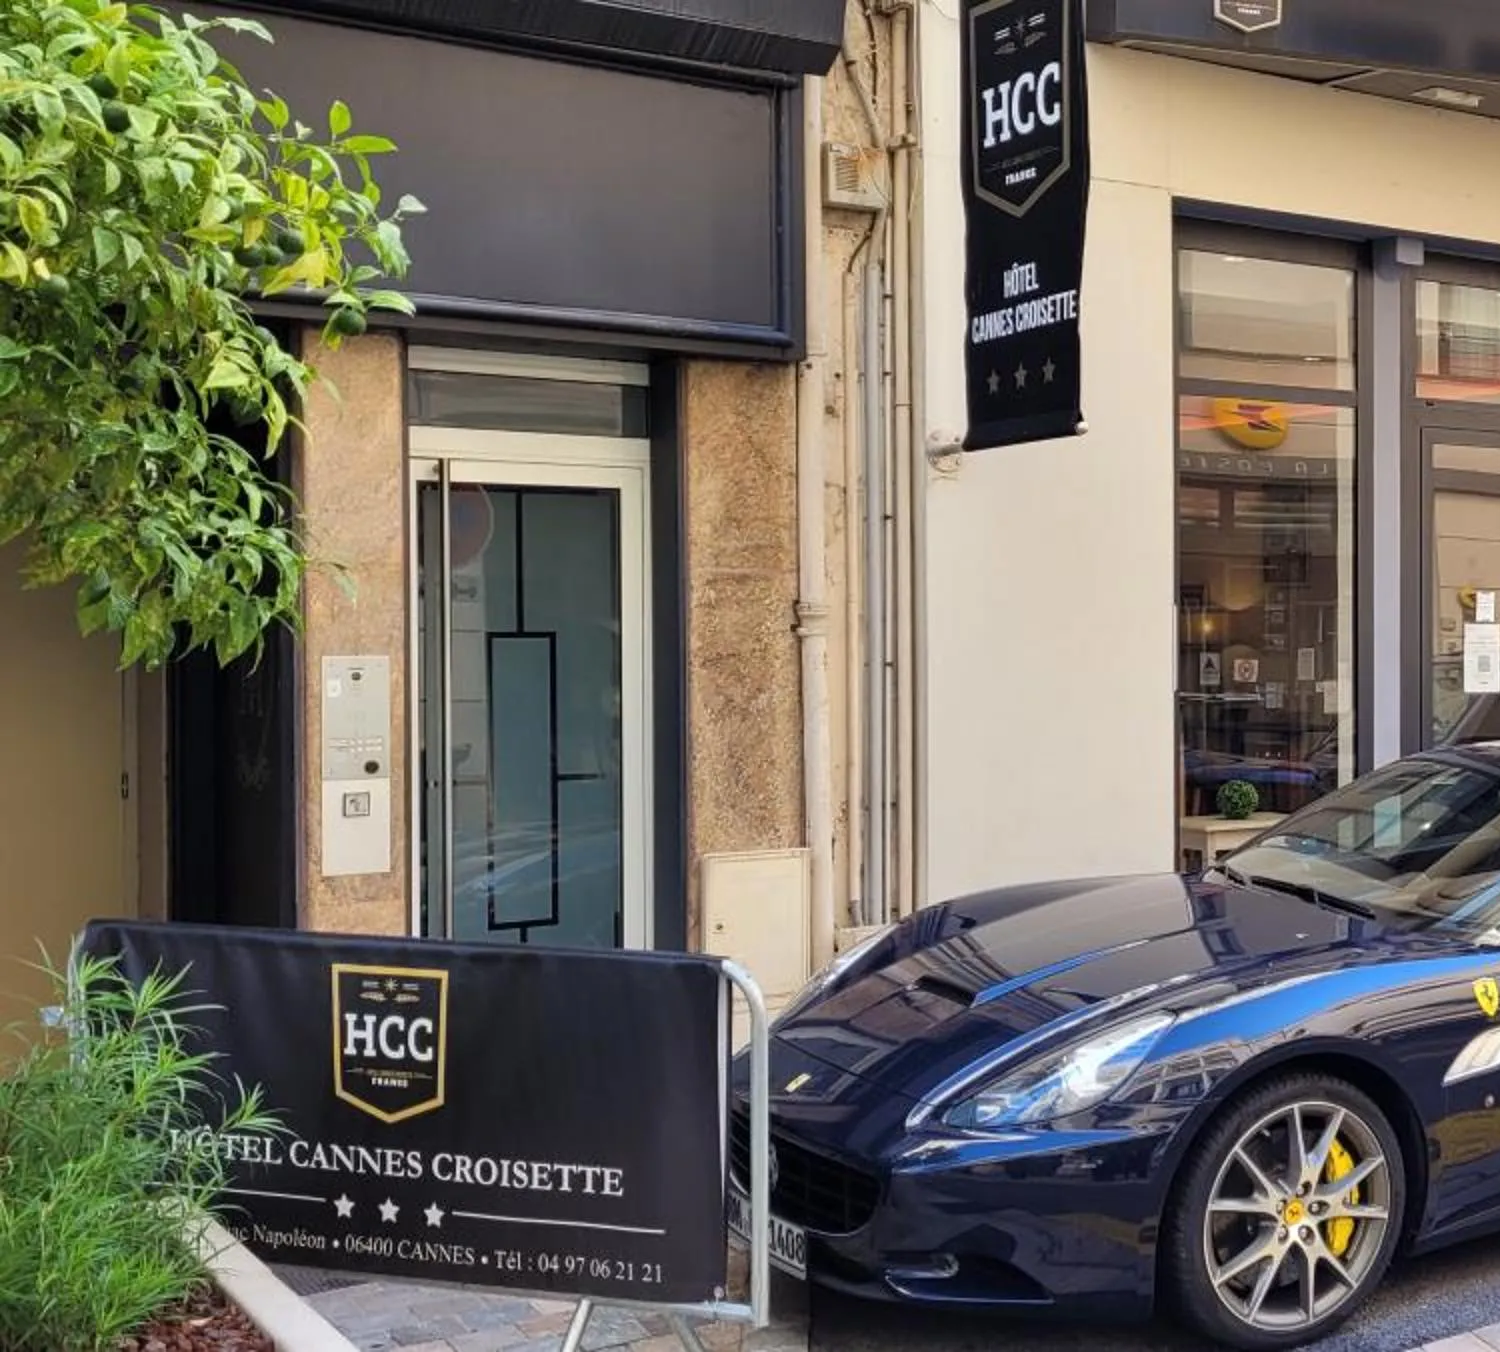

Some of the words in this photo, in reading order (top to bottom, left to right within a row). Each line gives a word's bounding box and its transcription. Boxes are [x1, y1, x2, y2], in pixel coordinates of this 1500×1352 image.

[982, 62, 1061, 148] HCC
[1003, 262, 1039, 298] HÔTEL
[972, 307, 1014, 343] CANNES
[1015, 290, 1077, 332] CROISETTE
[343, 1013, 434, 1062] HCC
[289, 1140, 423, 1179] CANNES
[432, 1152, 625, 1197] CROISETTE
[253, 1223, 326, 1250] Napoléon
[345, 1234, 393, 1257] 06400
[397, 1239, 476, 1266] CANNES
[494, 1250, 522, 1271] Tél
[538, 1252, 559, 1273] 04
[565, 1256, 585, 1277] 97
[589, 1258, 611, 1279] 06
[615, 1261, 634, 1281] 21
[641, 1263, 663, 1284] 21
